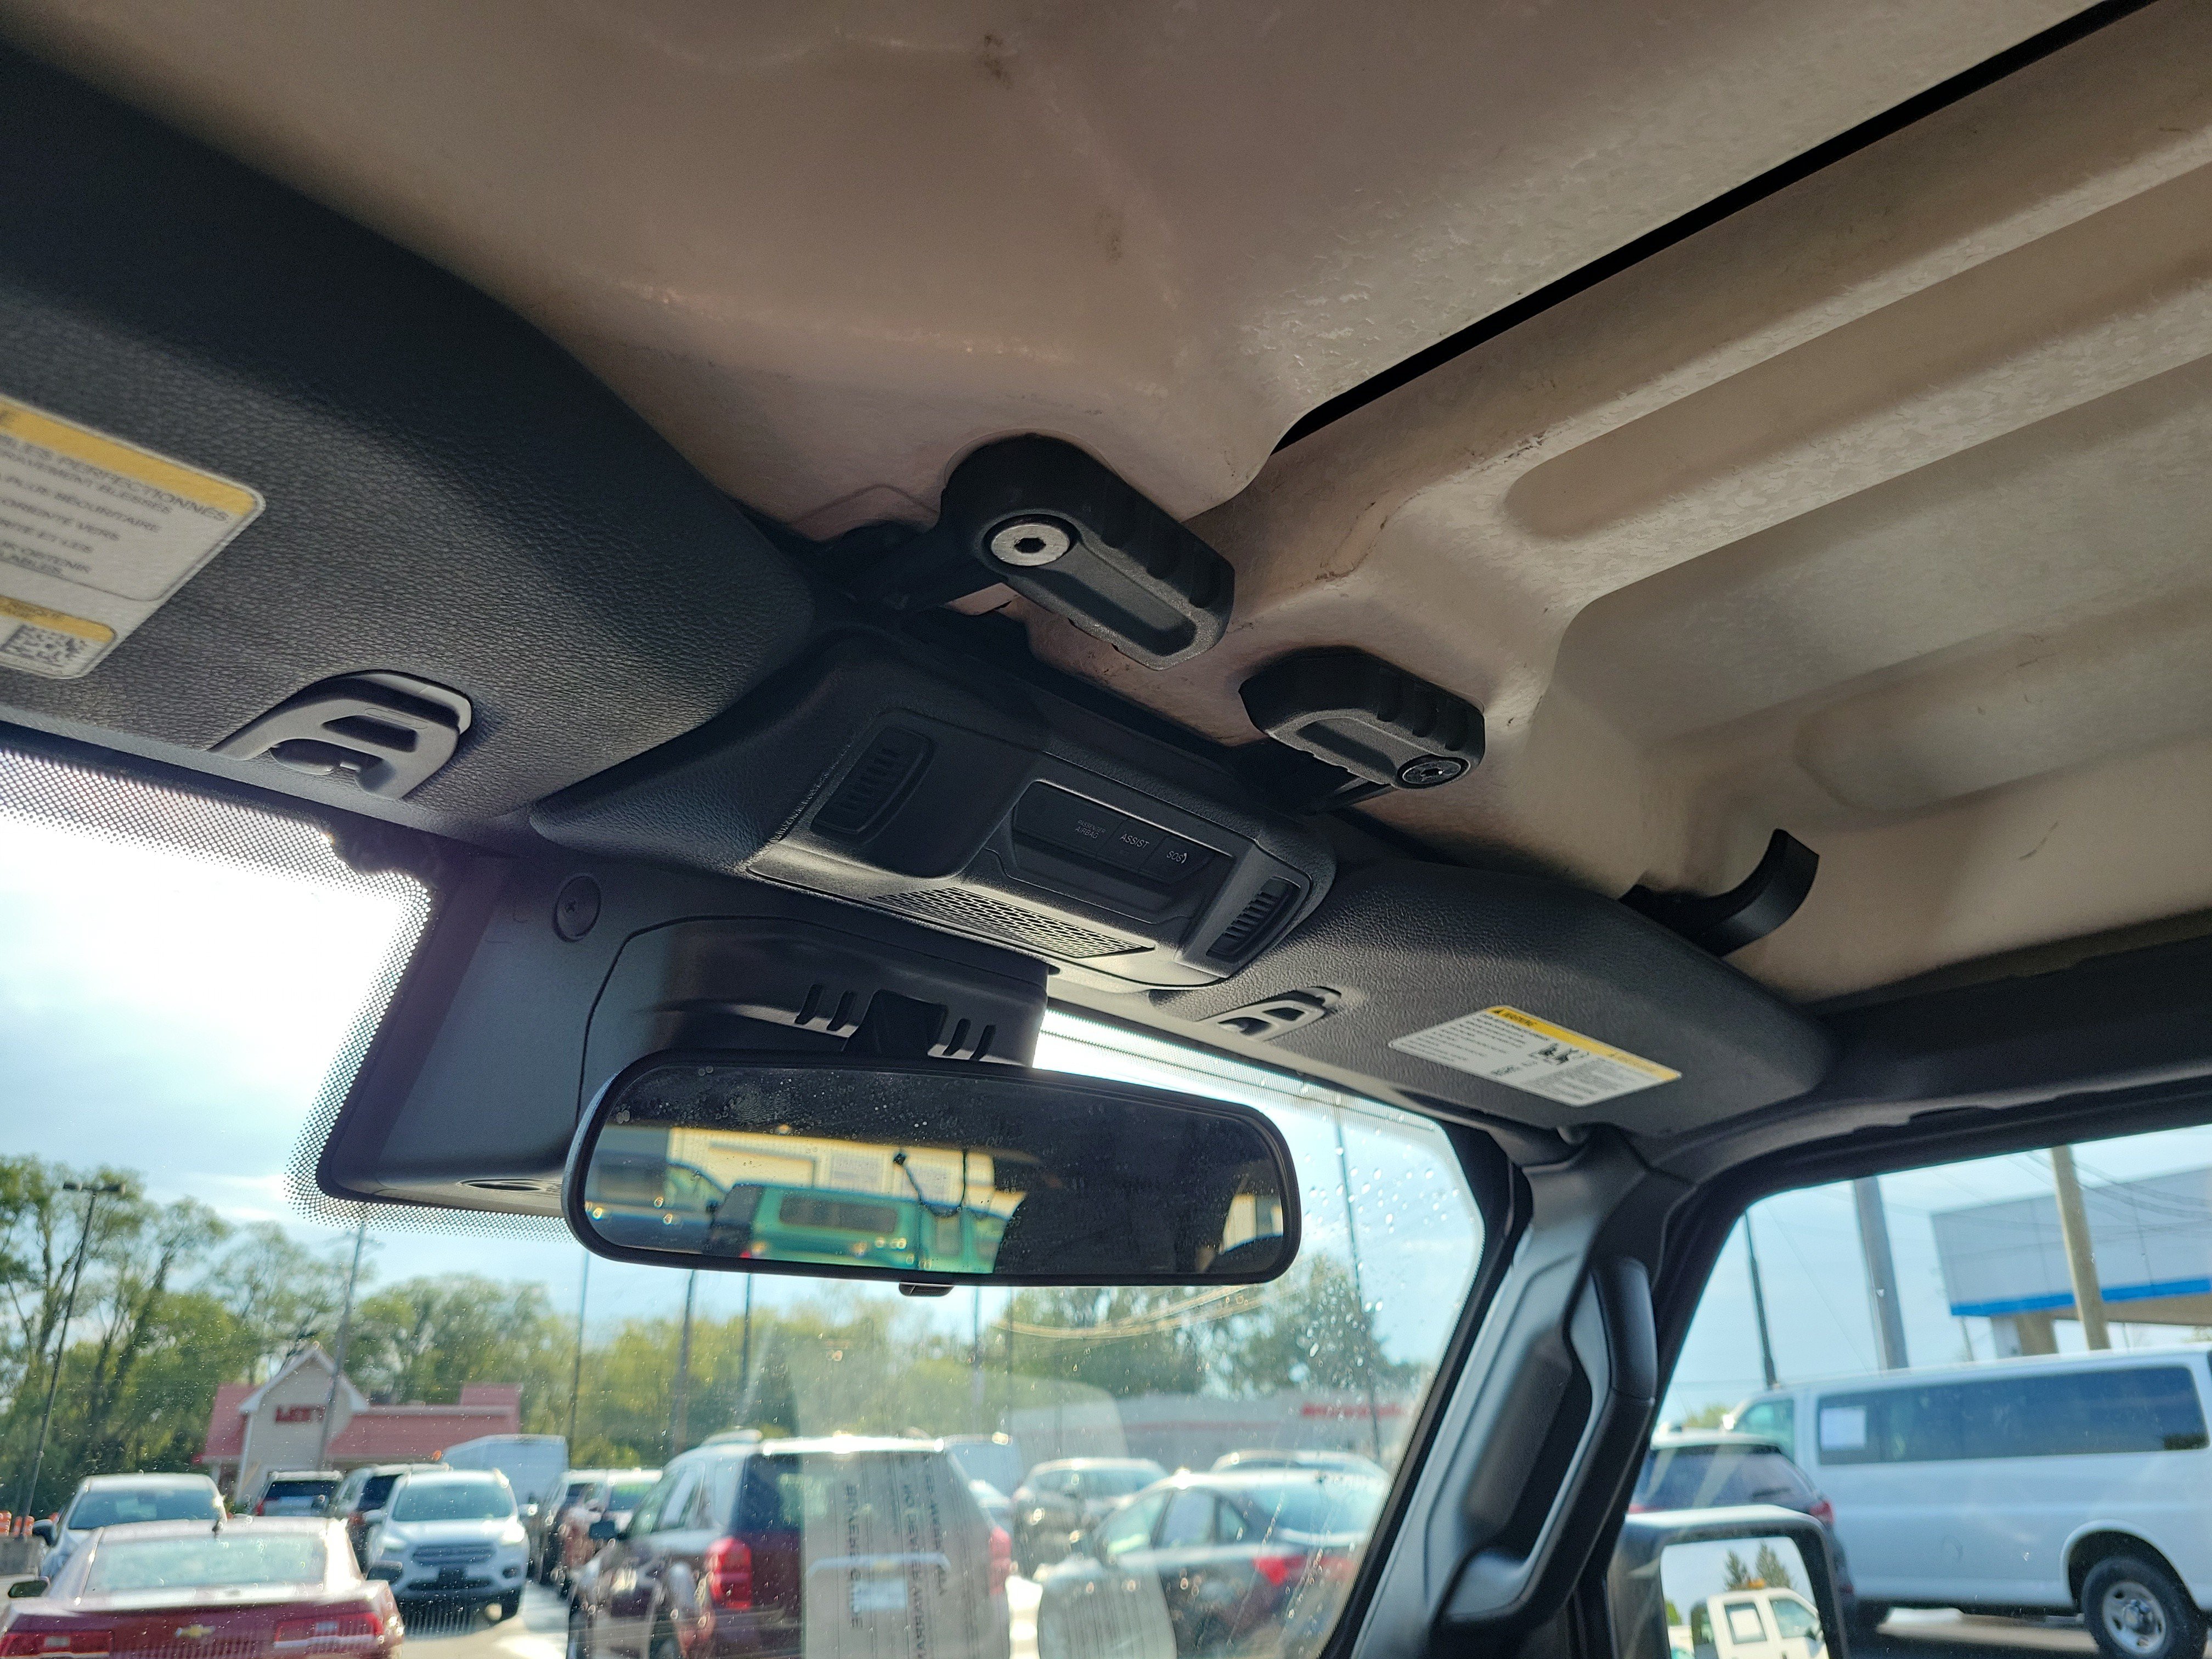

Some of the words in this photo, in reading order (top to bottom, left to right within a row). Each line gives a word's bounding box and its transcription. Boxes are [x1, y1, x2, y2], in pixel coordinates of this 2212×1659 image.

[1074, 826, 1099, 839] AIRBAG
[1119, 833, 1150, 849] ASSIST
[1166, 850, 1183, 862] SOS
